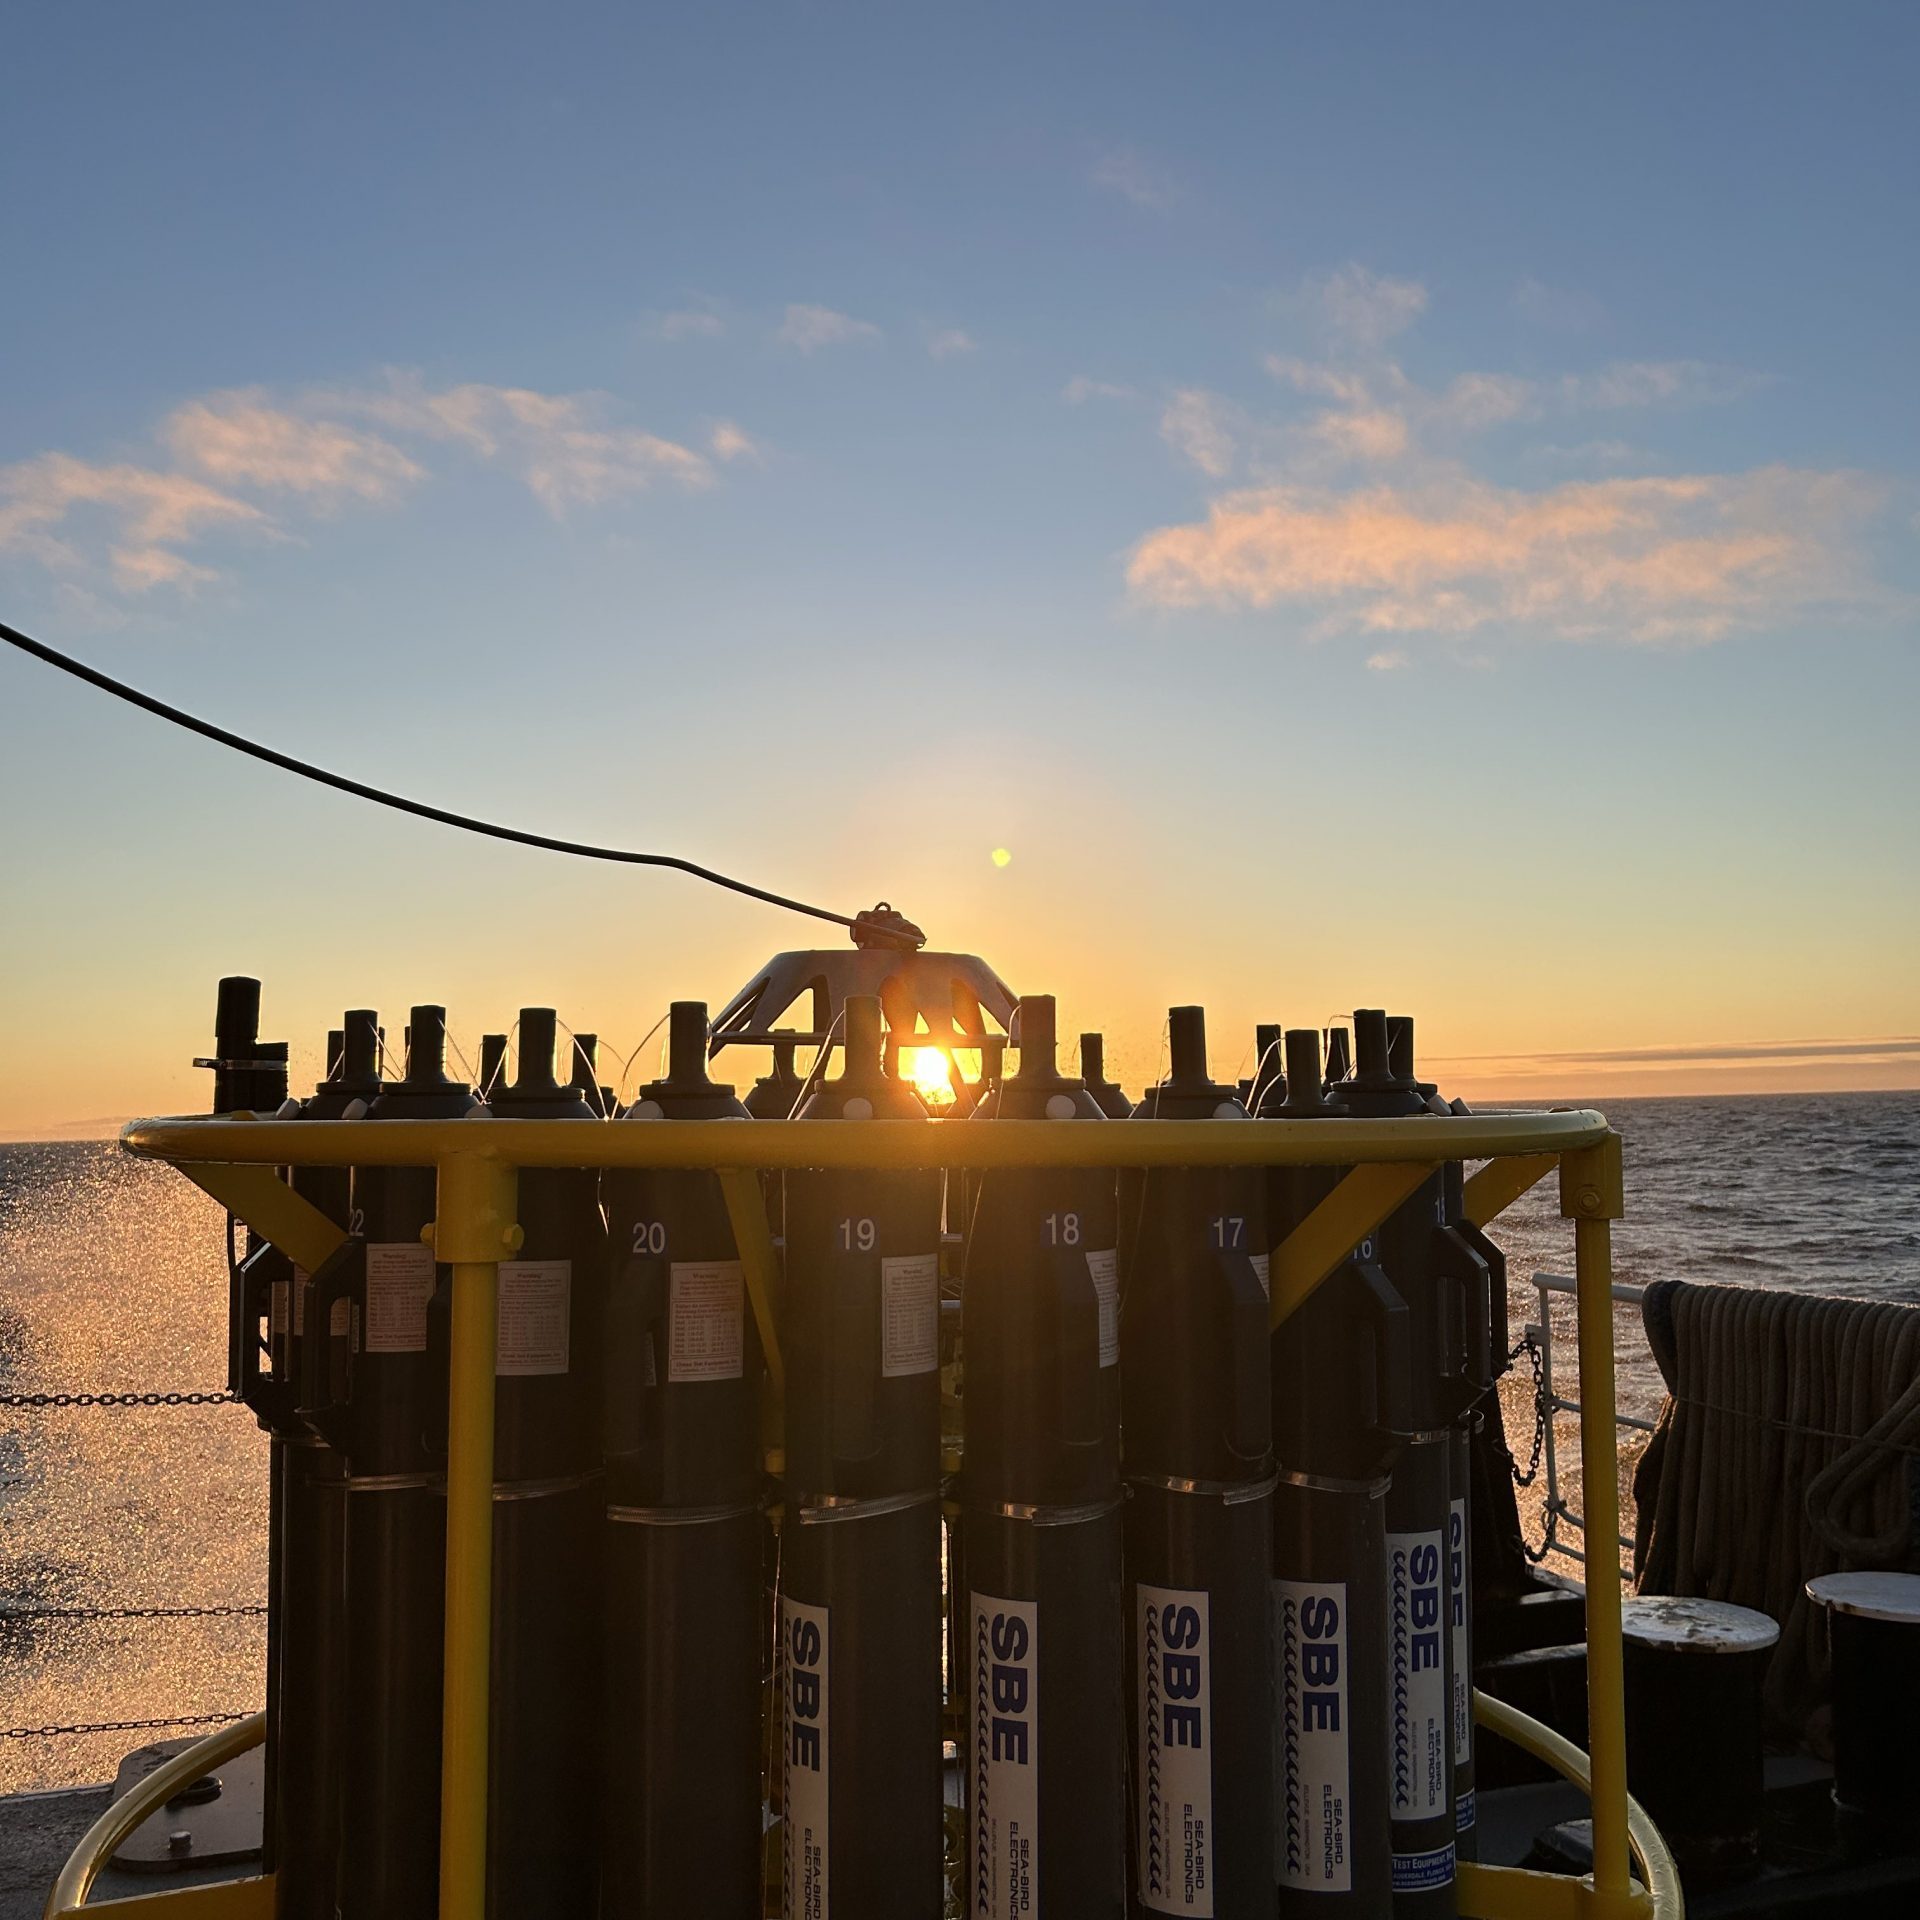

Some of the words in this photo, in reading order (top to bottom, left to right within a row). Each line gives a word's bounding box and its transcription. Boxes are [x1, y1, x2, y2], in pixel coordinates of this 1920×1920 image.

[632, 1222, 666, 1255] 20
[839, 1217, 876, 1252] 19
[1045, 1212, 1080, 1246] 18
[1212, 1216, 1244, 1248] 17
[1410, 1544, 1439, 1673] SBE
[792, 1618, 821, 1772] SBE
[991, 1613, 1029, 1766] SBE
[1162, 1604, 1202, 1749] SBE
[1300, 1596, 1340, 1733] SBE
[1428, 1718, 1436, 1806] ELECTRONICS
[1184, 1804, 1194, 1904] ELECTRONICS
[1194, 1820, 1204, 1890] SEA-BIRD
[1324, 1784, 1333, 1880] ELECTRONICS
[1334, 1798, 1343, 1865] SEA-BIRD
[813, 1846, 822, 1920] SEA-BIRD
[1020, 1839, 1029, 1911] SEA-BIRD
